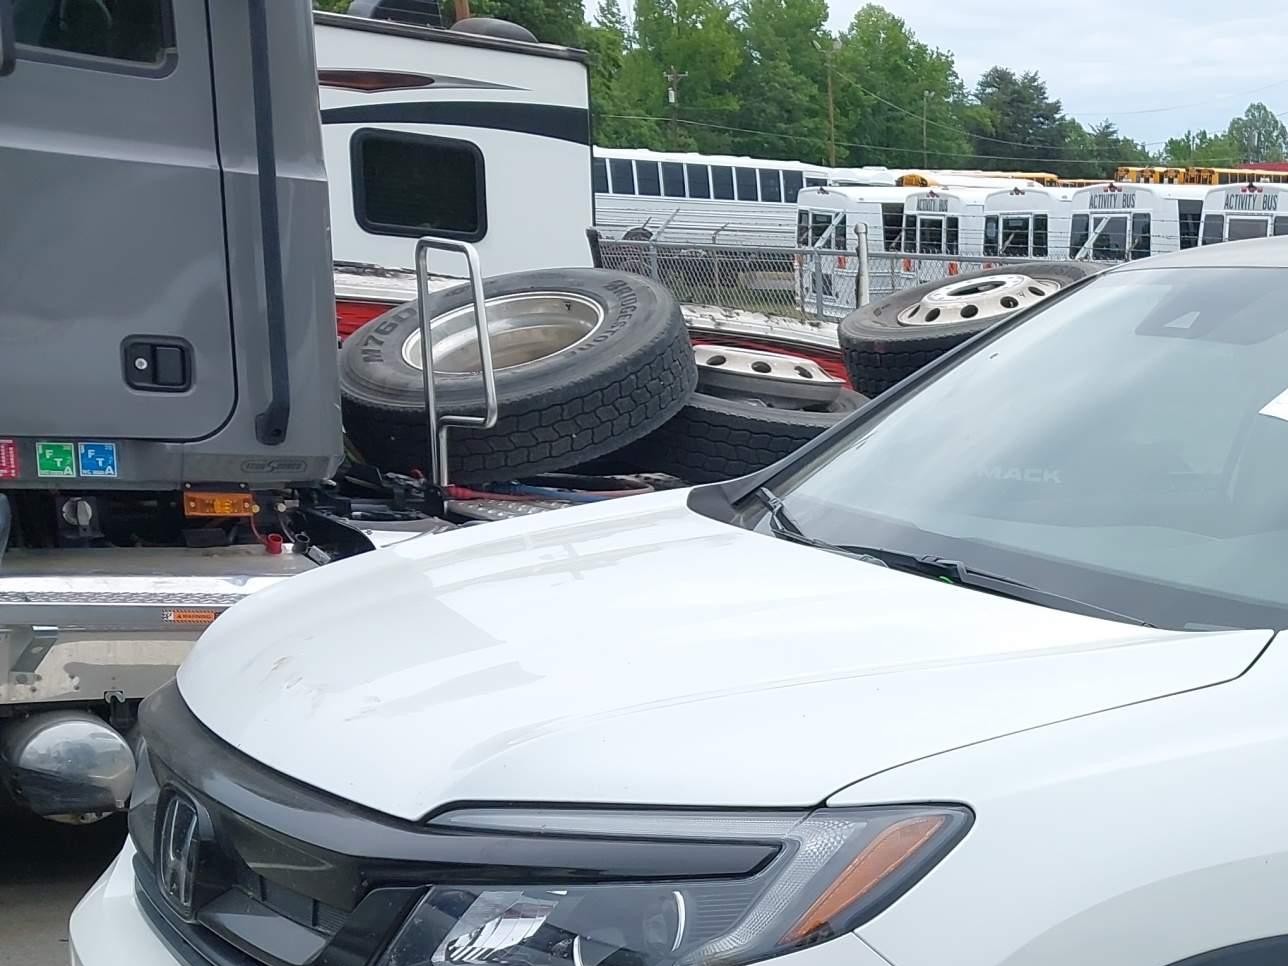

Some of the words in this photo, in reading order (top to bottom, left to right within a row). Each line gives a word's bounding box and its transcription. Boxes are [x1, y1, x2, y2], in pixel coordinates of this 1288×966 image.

[1089, 194, 1117, 209] ACTIVITY
[1121, 194, 1136, 209] BUS
[1224, 193, 1258, 211] ACTIVITY
[1262, 194, 1278, 211] BUS
[976, 463, 1063, 484] MACK
